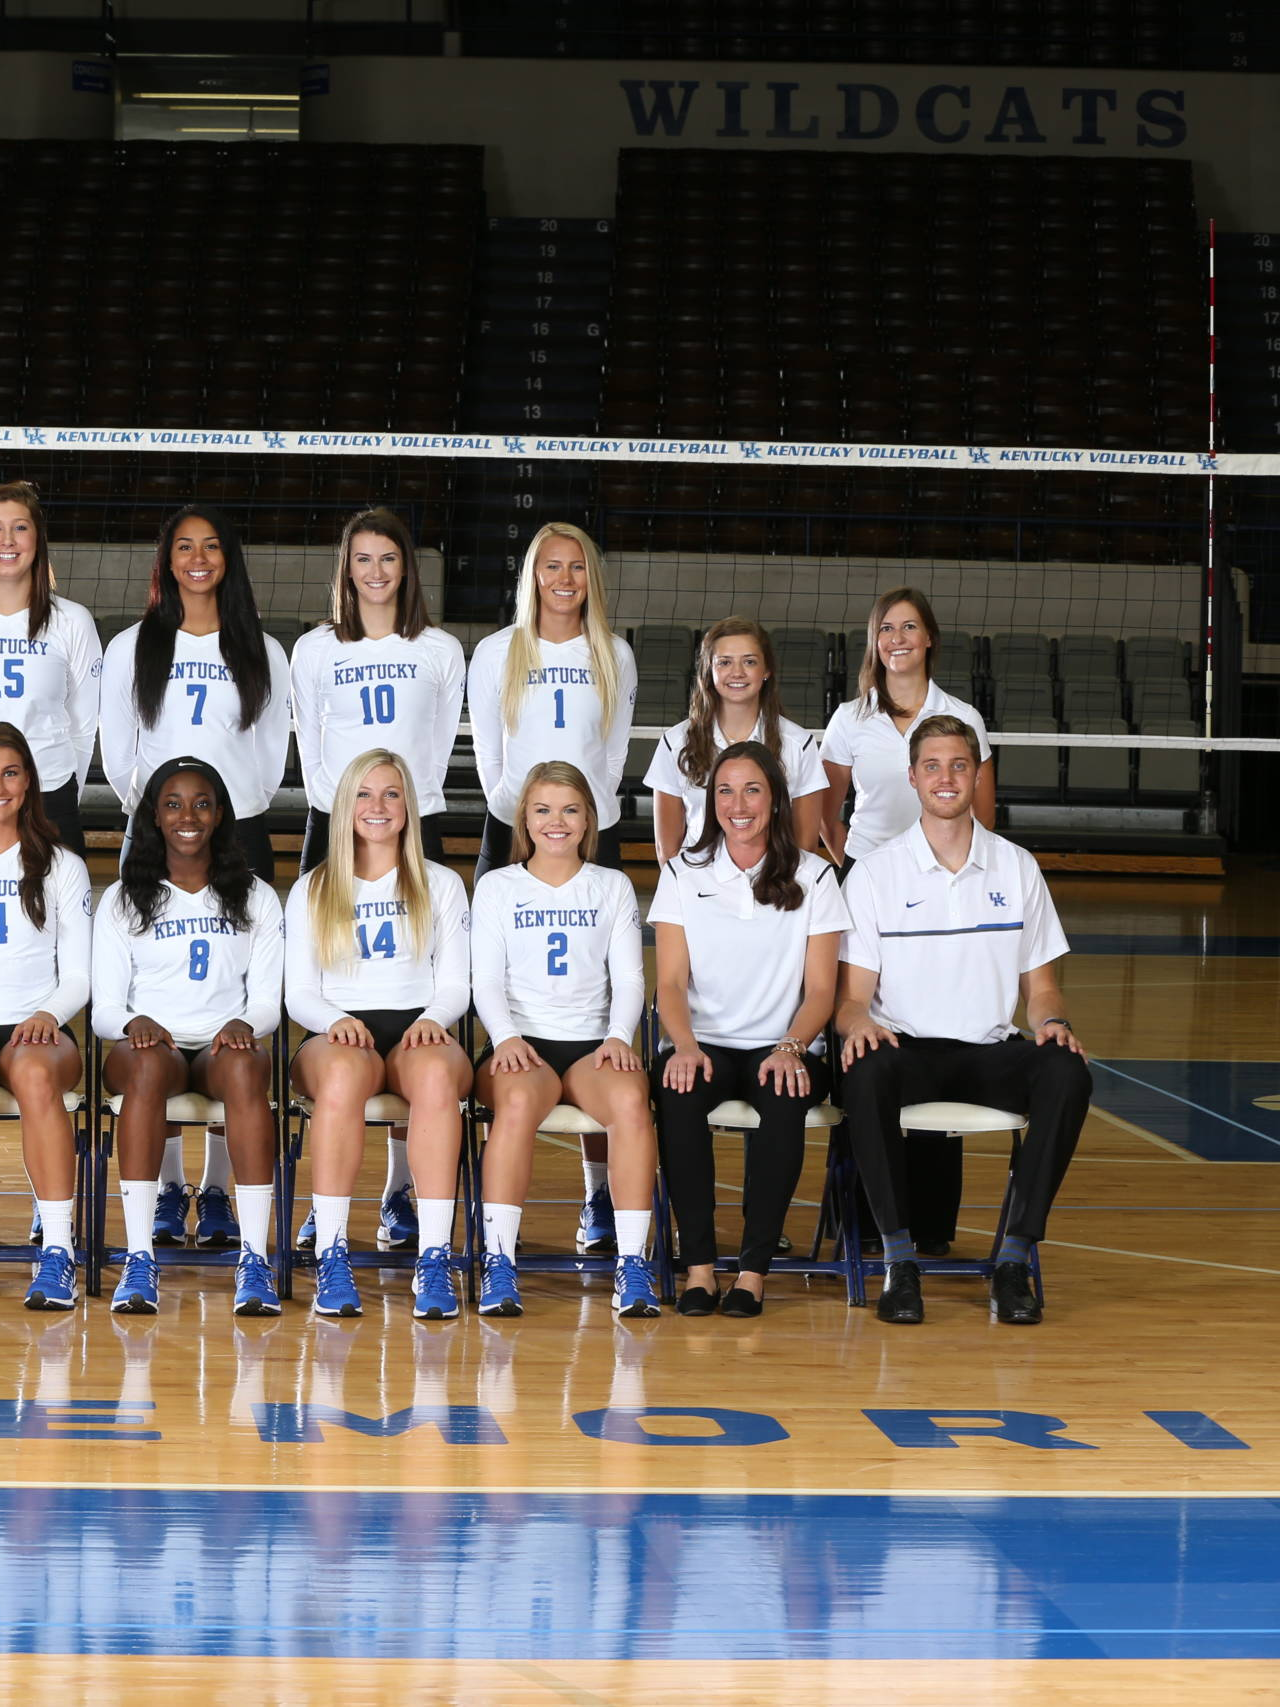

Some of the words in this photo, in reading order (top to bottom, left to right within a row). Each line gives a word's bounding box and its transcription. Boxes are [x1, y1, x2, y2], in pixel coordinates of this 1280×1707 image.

[619, 79, 1188, 149] WILDCATS
[540, 219, 557, 232] 20
[1252, 234, 1271, 247] 20
[540, 244, 556, 258] 19
[1257, 259, 1274, 272] 19
[536, 272, 555, 284] 18
[1260, 286, 1277, 299] 18
[536, 296, 552, 309] 17
[1263, 312, 1280, 325] 17
[532, 322, 550, 335] 16
[529, 350, 547, 363] 15
[525, 377, 542, 390] 14
[523, 404, 542, 419] 13
[55, 431, 142, 442] KENTUCKY
[149, 432, 252, 444] VOLLEYBALL
[297, 435, 383, 446] KENTUCKY
[390, 437, 491, 449] VOLLEYBALL
[535, 440, 621, 451] KENTUCKY
[628, 442, 727, 453] VOLLEYBALL
[766, 446, 850, 456] KENTUCKY
[859, 448, 956, 459] VOLLEYBALL
[999, 451, 1082, 462] KENTUCKY
[1089, 453, 1186, 465] VOLLEYBALL
[517, 464, 533, 478] 11
[513, 494, 533, 509] 10
[508, 524, 518, 539] 9
[334, 662, 418, 686] KENTUCKY
[527, 667, 596, 685] ENTUCKY
[186, 684, 207, 725] 7
[359, 684, 396, 725] 10
[554, 688, 565, 728] 1
[514, 907, 598, 930] KENTUCKY
[154, 917, 239, 940] KENTUCKY
[356, 921, 396, 959] 14
[188, 939, 210, 981] 8
[547, 932, 569, 977] 2
